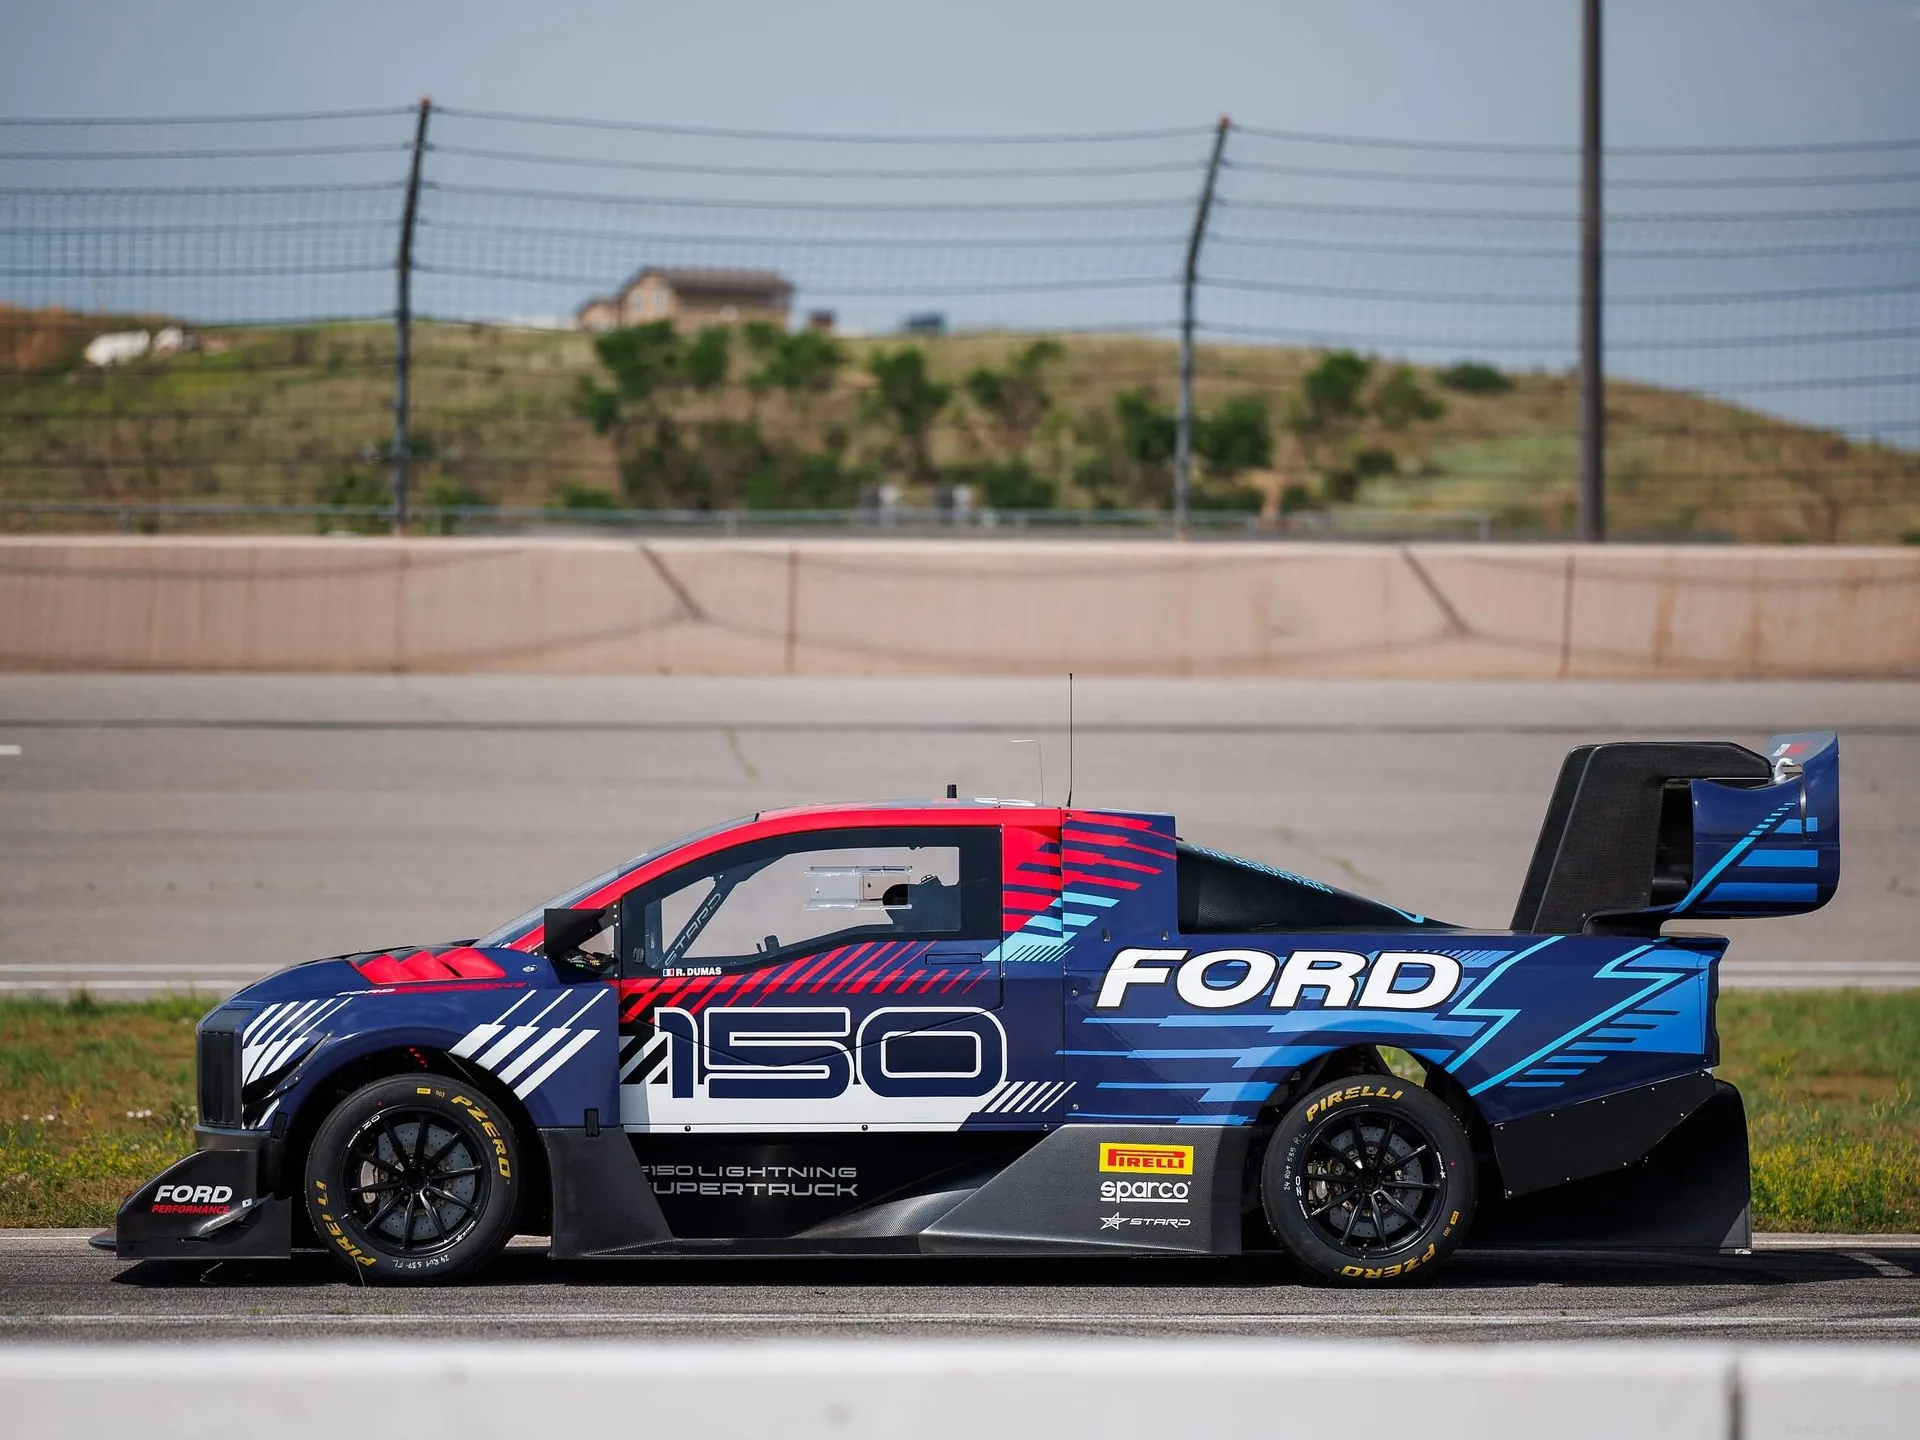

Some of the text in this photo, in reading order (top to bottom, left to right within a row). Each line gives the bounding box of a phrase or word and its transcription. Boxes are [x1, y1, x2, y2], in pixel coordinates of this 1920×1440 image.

[665, 893, 722, 968] STARD
[675, 966, 722, 977] R. DUMAS
[1094, 947, 1462, 1009] FORD
[654, 1006, 1008, 1100] 150
[1305, 1085, 1404, 1122] PIRELLI
[1108, 1149, 1186, 1169] PIRELLI
[698, 1166, 858, 1178] LIGHTNING
[154, 1185, 233, 1203] FORD
[649, 1182, 858, 1196] UPERTRUCK
[1100, 1181, 1189, 1203] sparco
[151, 1204, 230, 1215] PERFORMANCE
[1129, 1217, 1191, 1229] STARD
